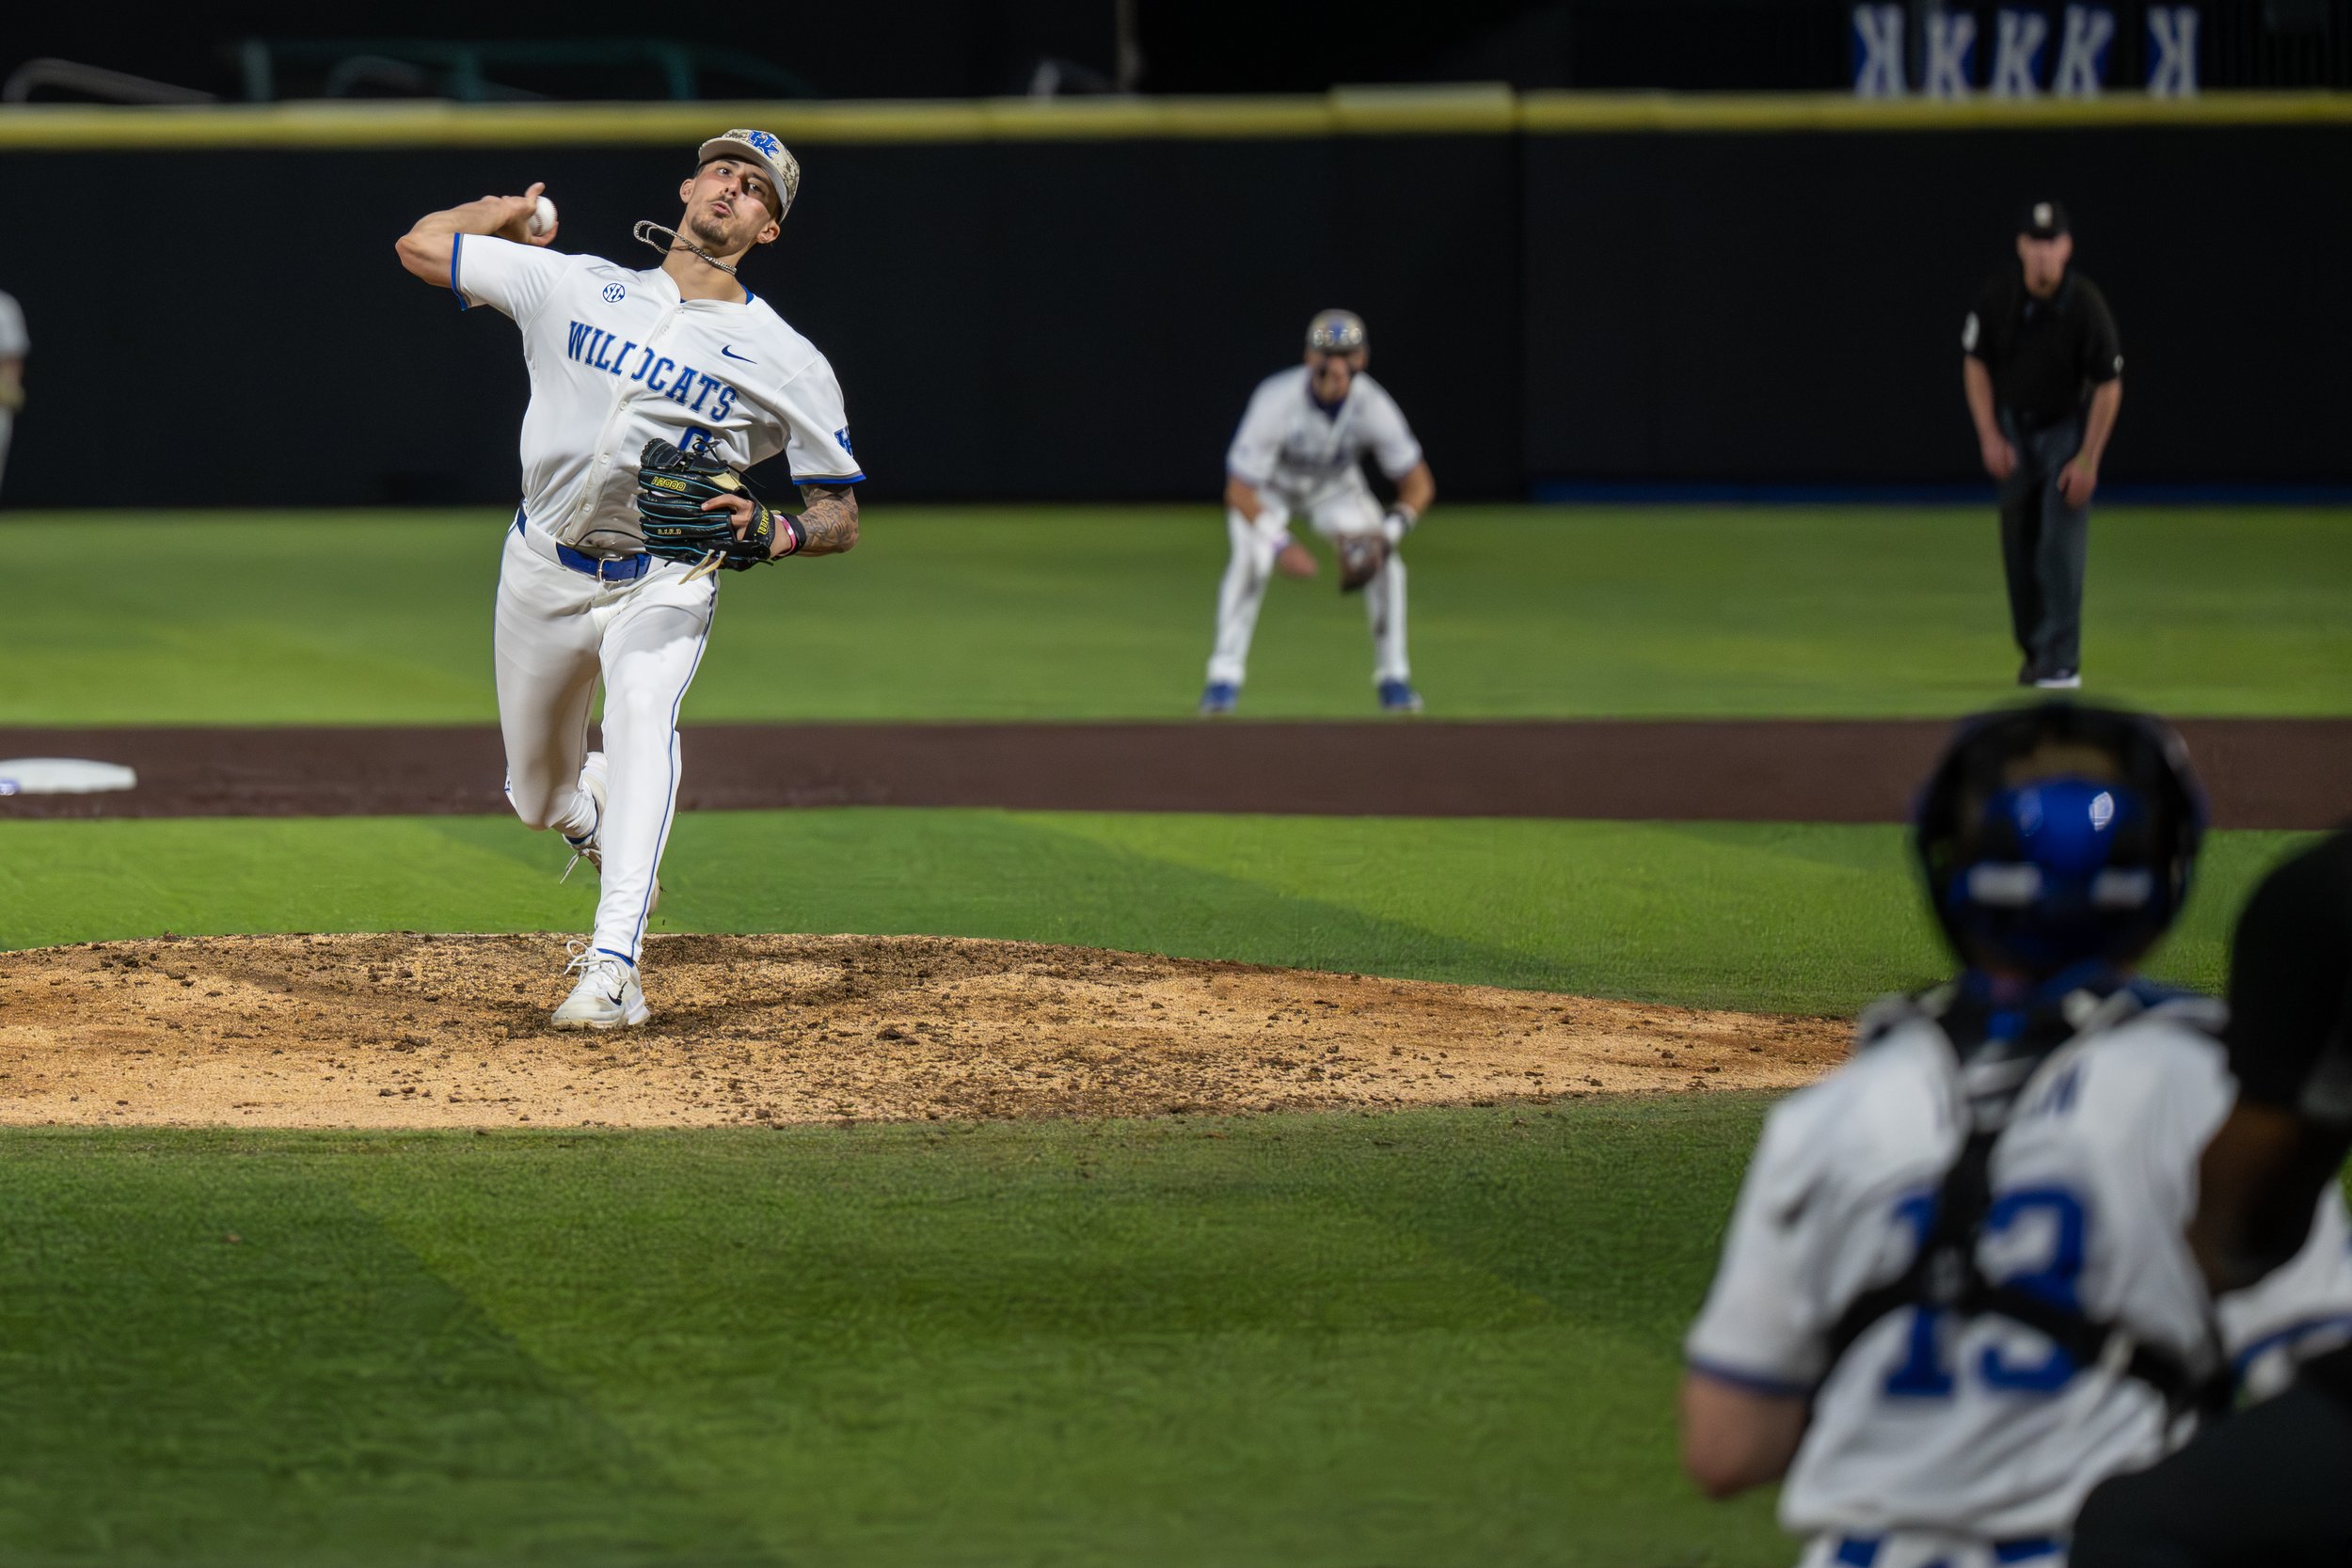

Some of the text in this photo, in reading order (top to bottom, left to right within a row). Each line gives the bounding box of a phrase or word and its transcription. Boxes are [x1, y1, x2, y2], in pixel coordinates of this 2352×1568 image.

[1925, 10, 1977, 97] K
[1992, 8, 2047, 97] K
[2052, 5, 2114, 97] K
[603, 283, 626, 303] SEC
[568, 321, 738, 421] WILDCATS
